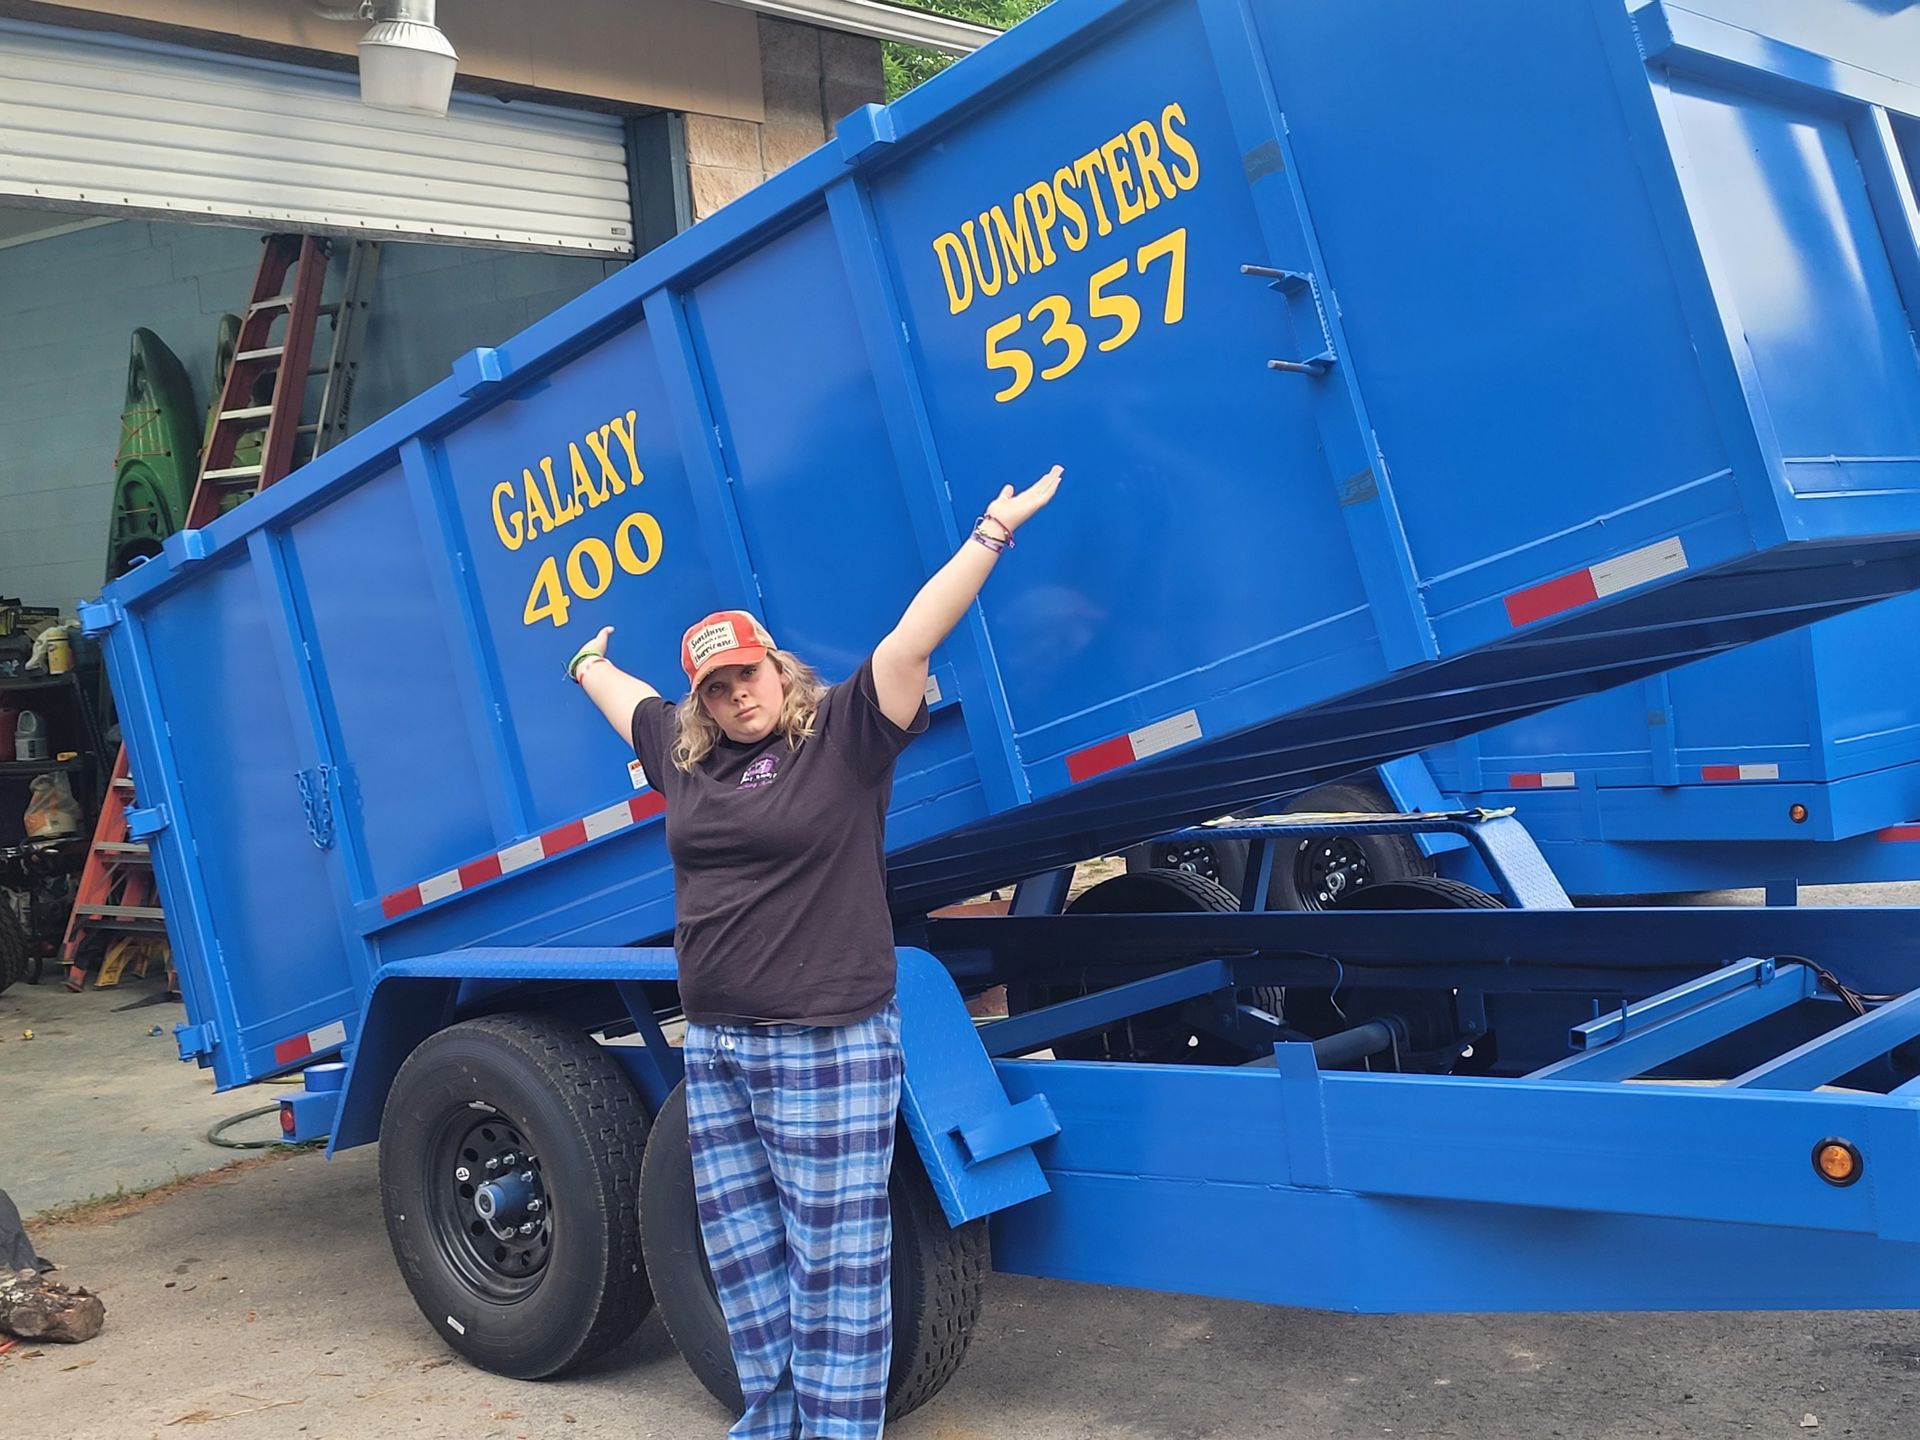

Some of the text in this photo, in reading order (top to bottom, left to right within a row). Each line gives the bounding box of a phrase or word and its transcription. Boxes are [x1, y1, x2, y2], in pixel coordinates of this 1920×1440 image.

[491, 102, 1200, 550] GALAXY DUMPSTERS
[523, 227, 1187, 627] 400 5357
